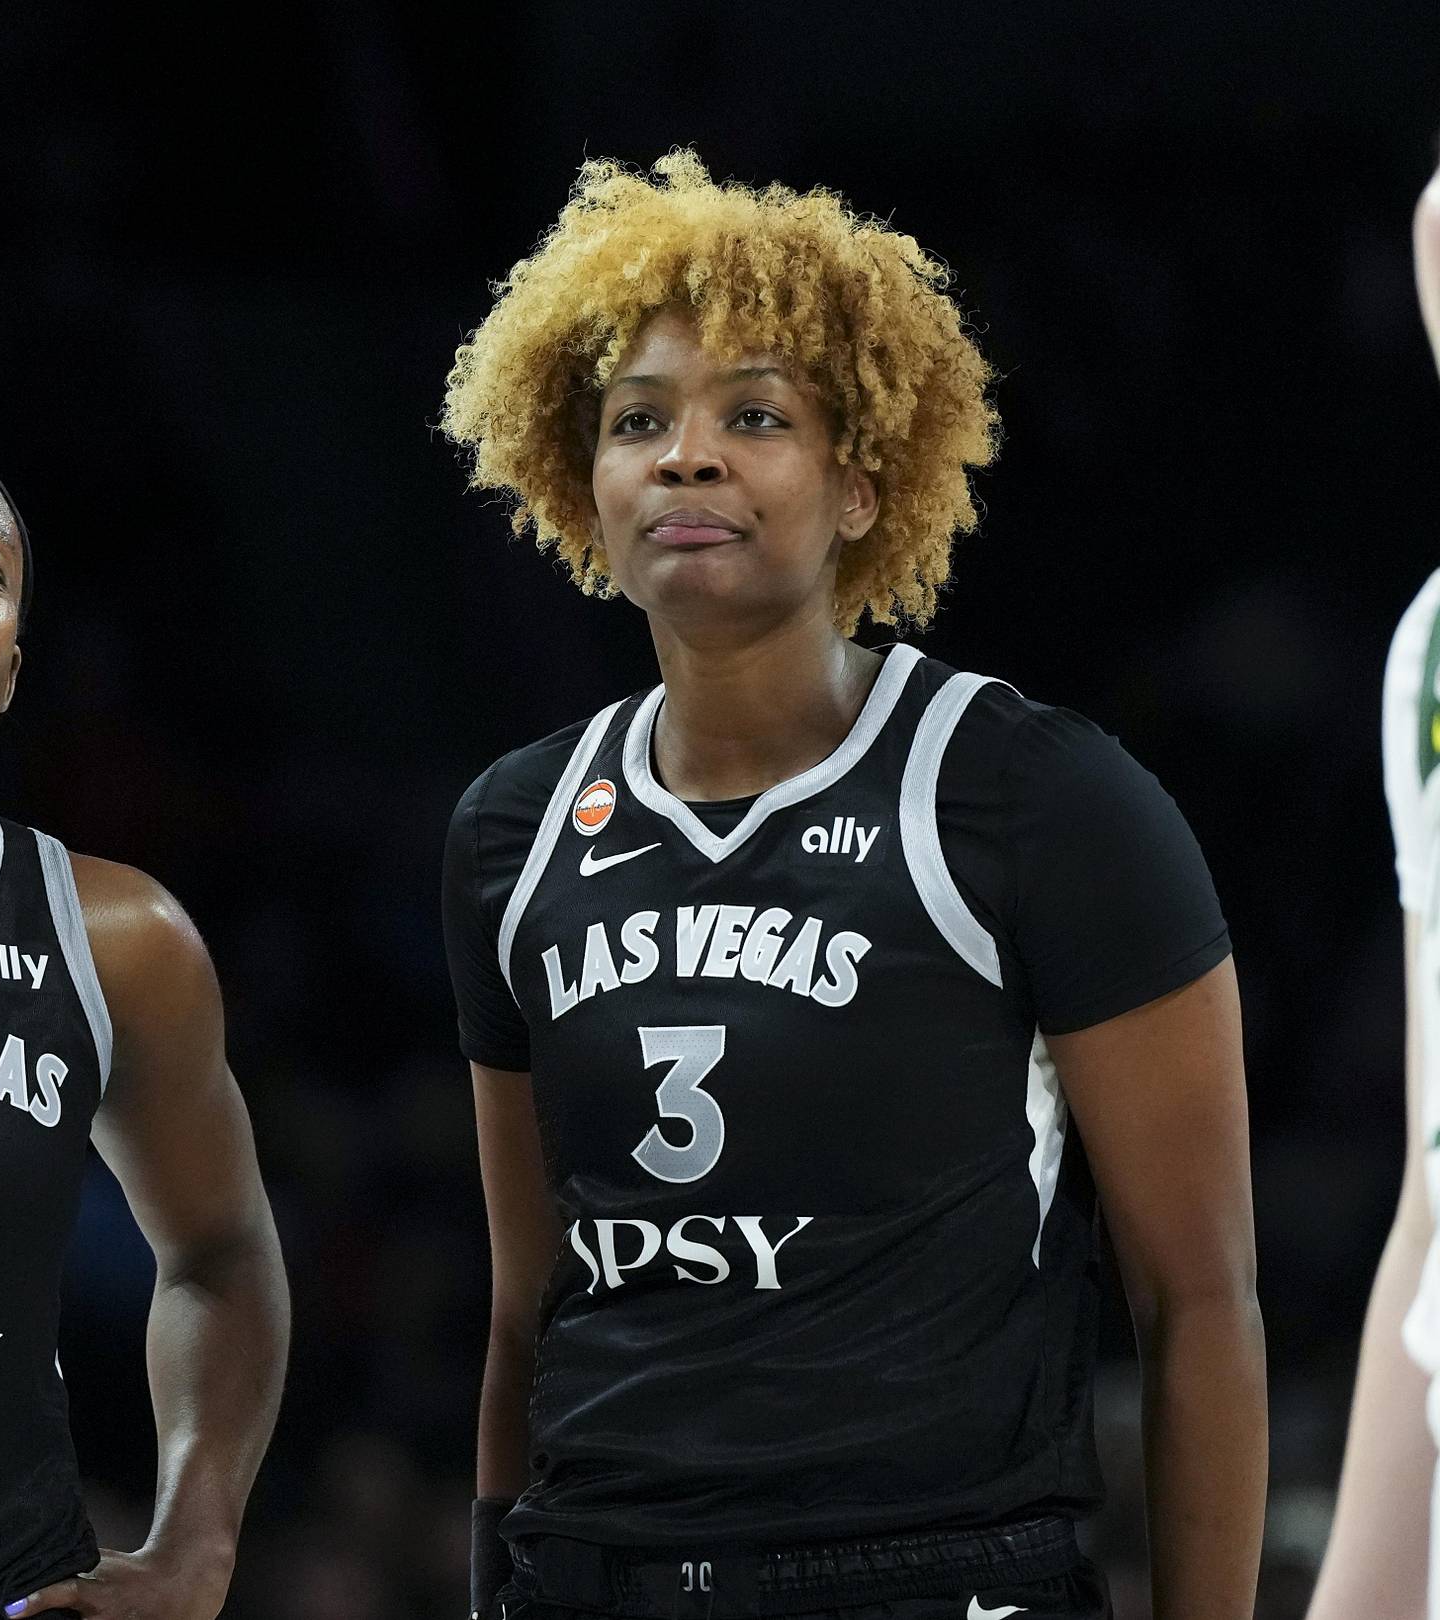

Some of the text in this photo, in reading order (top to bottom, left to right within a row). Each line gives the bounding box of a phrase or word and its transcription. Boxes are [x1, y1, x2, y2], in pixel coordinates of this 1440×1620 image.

[801, 816, 881, 863] ally
[541, 904, 872, 1021] LAS VEGAS
[630, 1024, 727, 1184] 3
[569, 1214, 814, 1296] IPSY
